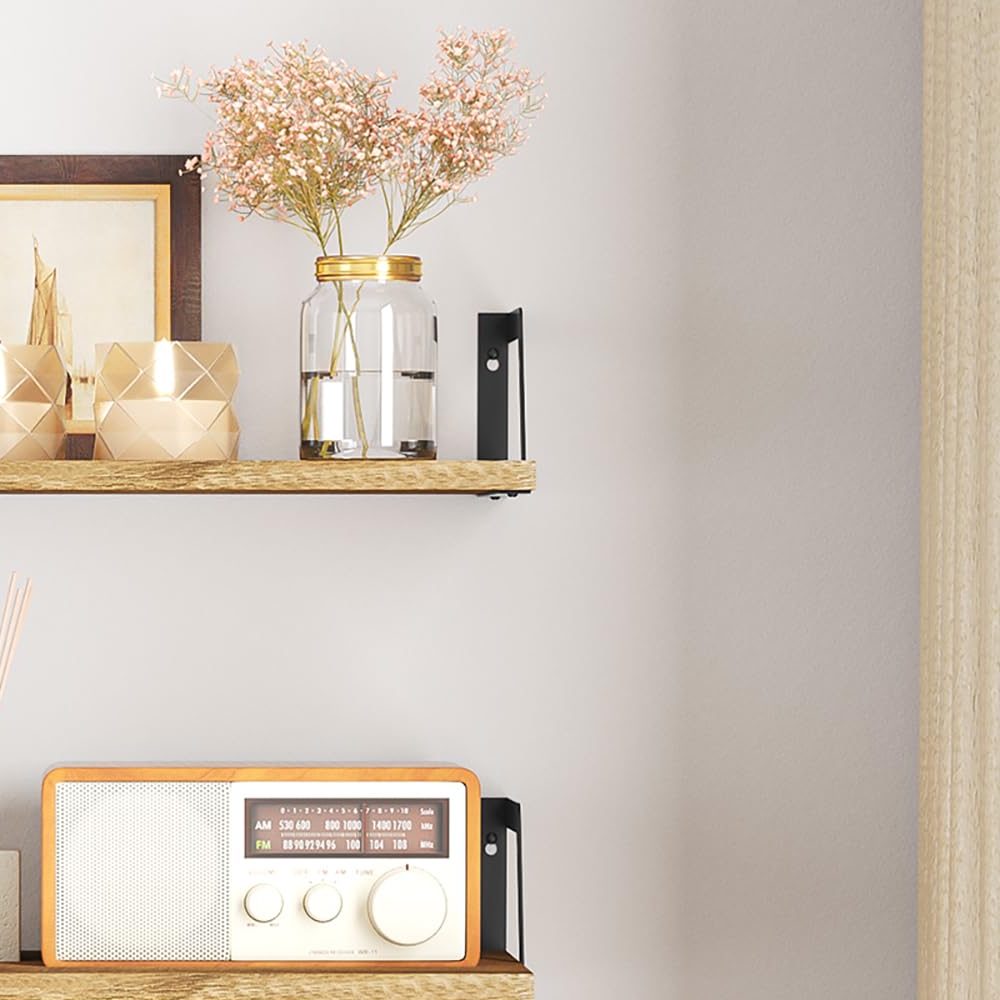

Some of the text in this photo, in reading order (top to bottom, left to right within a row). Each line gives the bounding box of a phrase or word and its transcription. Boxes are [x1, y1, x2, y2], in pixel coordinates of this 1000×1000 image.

[255, 820, 272, 831] AM
[279, 819, 295, 831] 530
[295, 819, 311, 831] 600
[325, 819, 340, 831] 800
[343, 819, 362, 831] 1000
[372, 819, 392, 831] 1400
[392, 819, 412, 831] 1700
[255, 839, 271, 850] FM
[283, 839, 294, 850] 88
[294, 839, 304, 850] 90
[305, 839, 315, 850] 92
[315, 839, 325, 850] 94
[326, 839, 337, 850] 96
[346, 839, 361, 850] 100
[369, 839, 384, 850] 104
[393, 839, 408, 850] 108
